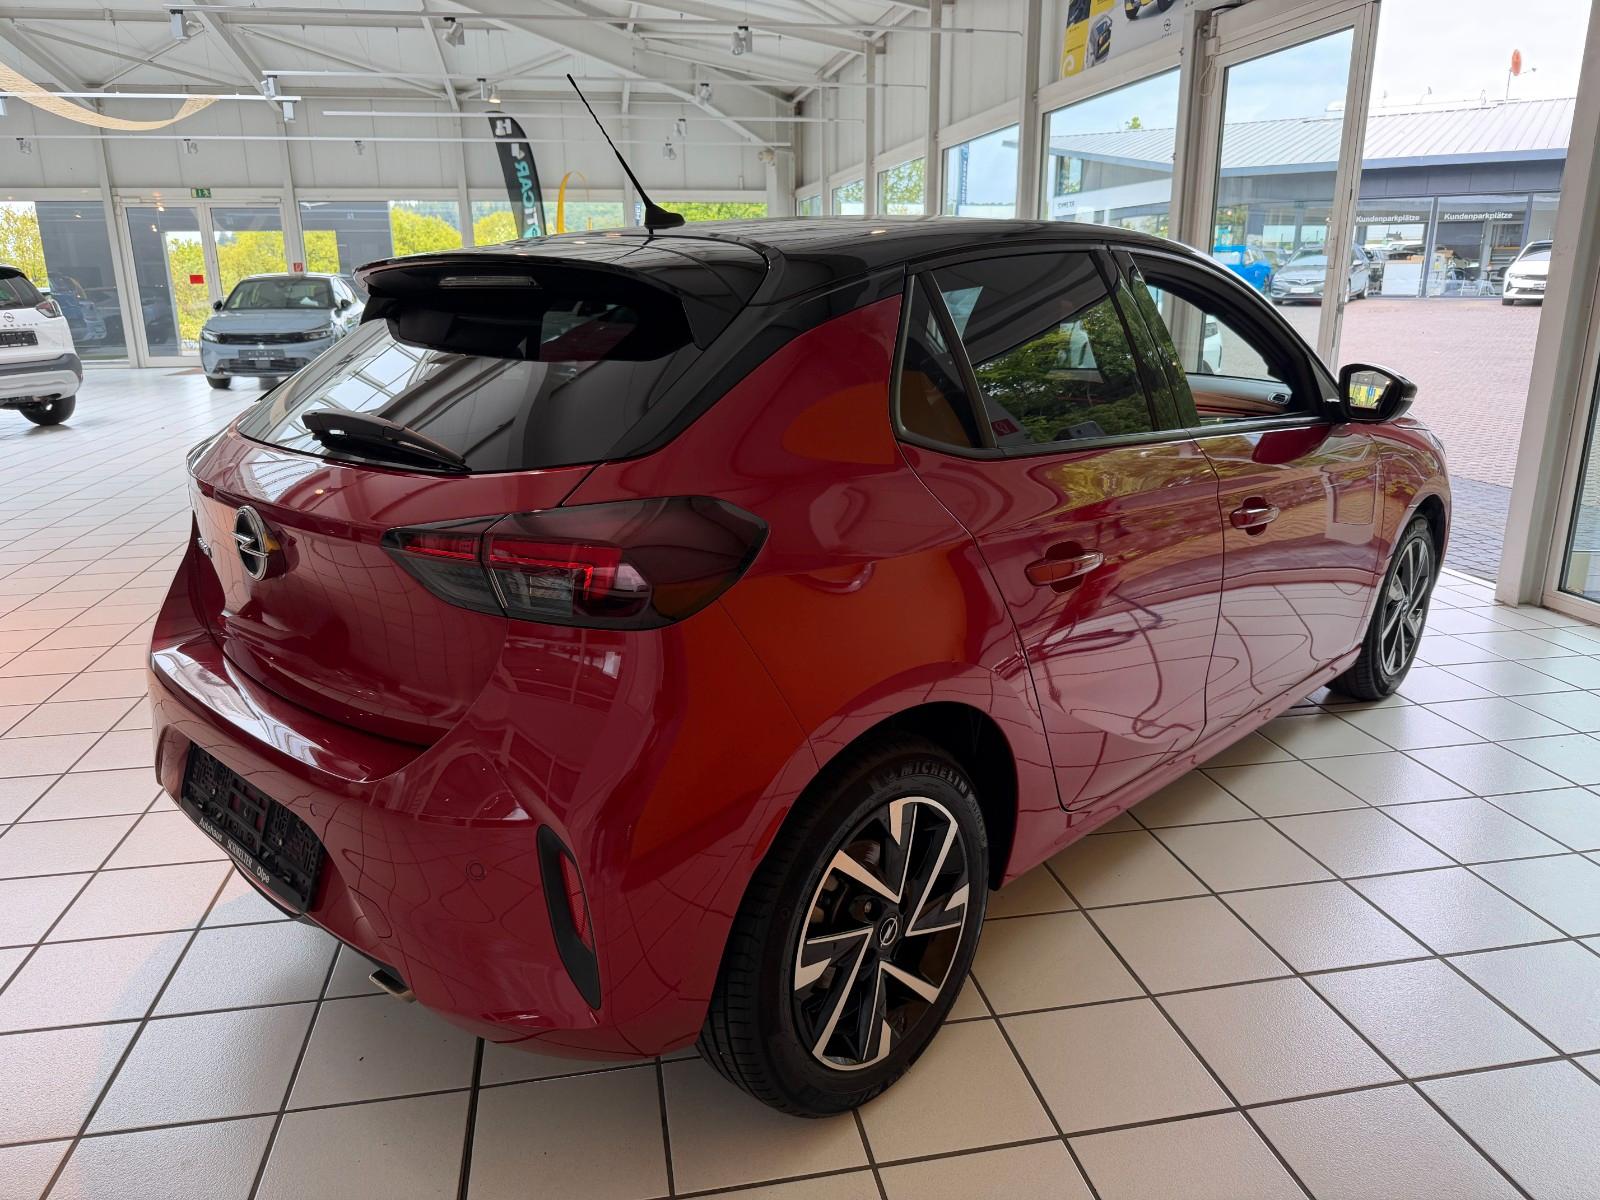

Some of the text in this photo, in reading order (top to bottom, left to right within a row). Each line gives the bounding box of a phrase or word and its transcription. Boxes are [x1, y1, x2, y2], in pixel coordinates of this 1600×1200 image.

[1356, 214, 1420, 223] Kundenparkplätze
[1444, 212, 1513, 221] Kundenparkplätze
[901, 762, 968, 794] MICHELIN
[256, 866, 270, 883] Olpe
